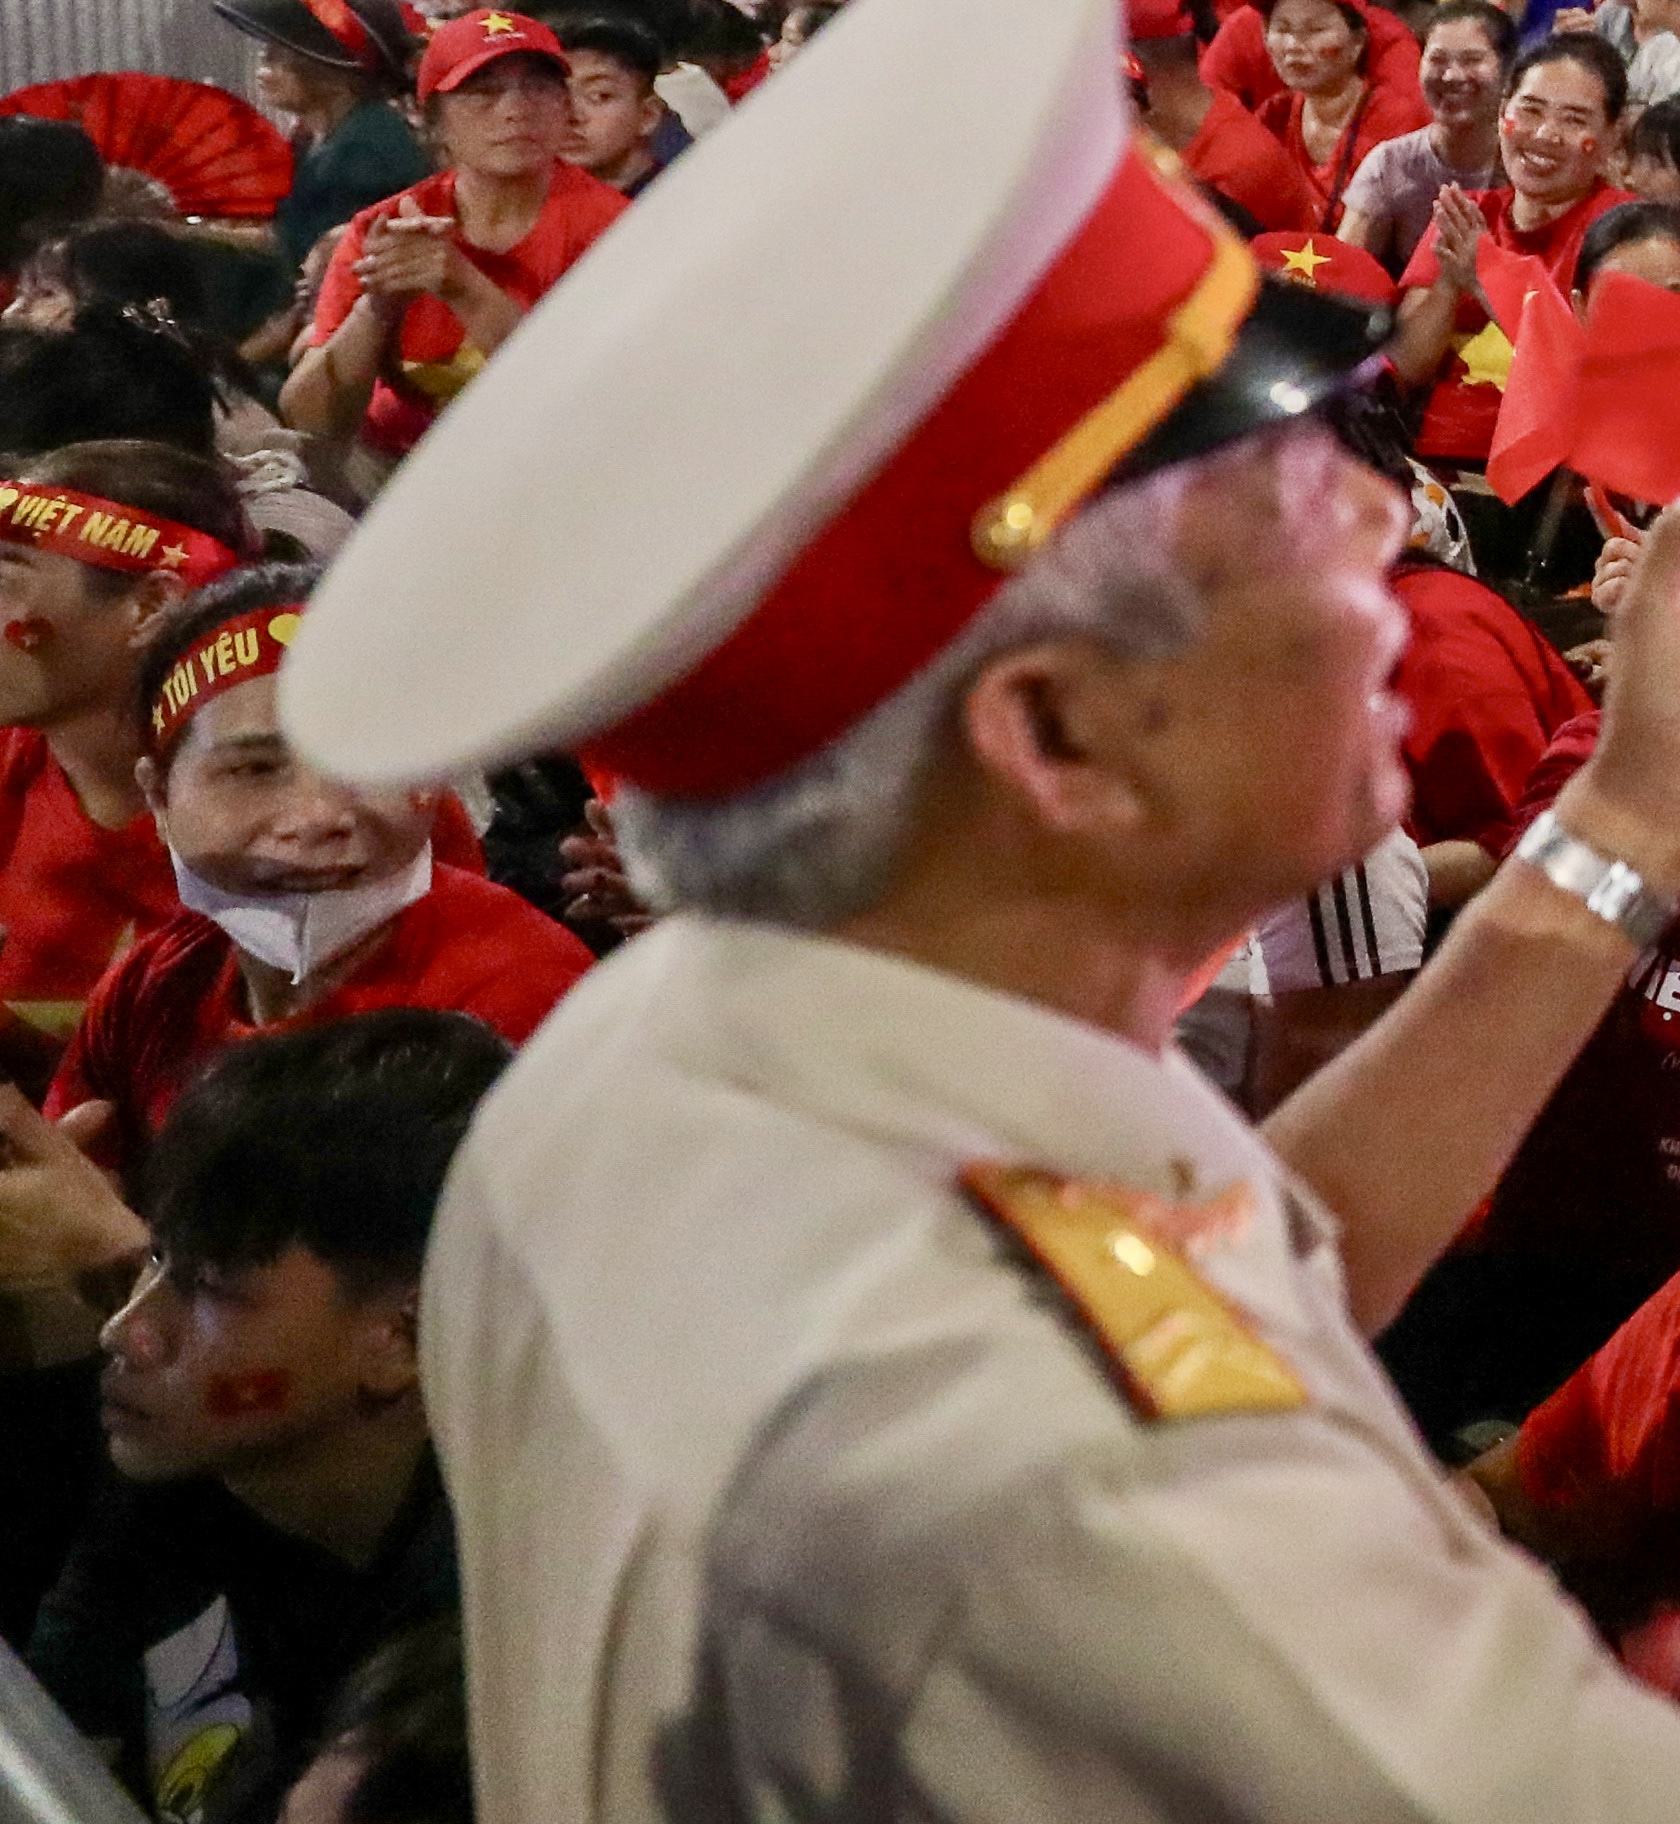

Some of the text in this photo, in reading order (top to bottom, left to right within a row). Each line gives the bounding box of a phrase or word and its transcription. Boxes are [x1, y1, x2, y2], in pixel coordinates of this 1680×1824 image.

[10, 494, 160, 559] VIỆT NAM
[162, 628, 259, 716] TÔI YÊU
